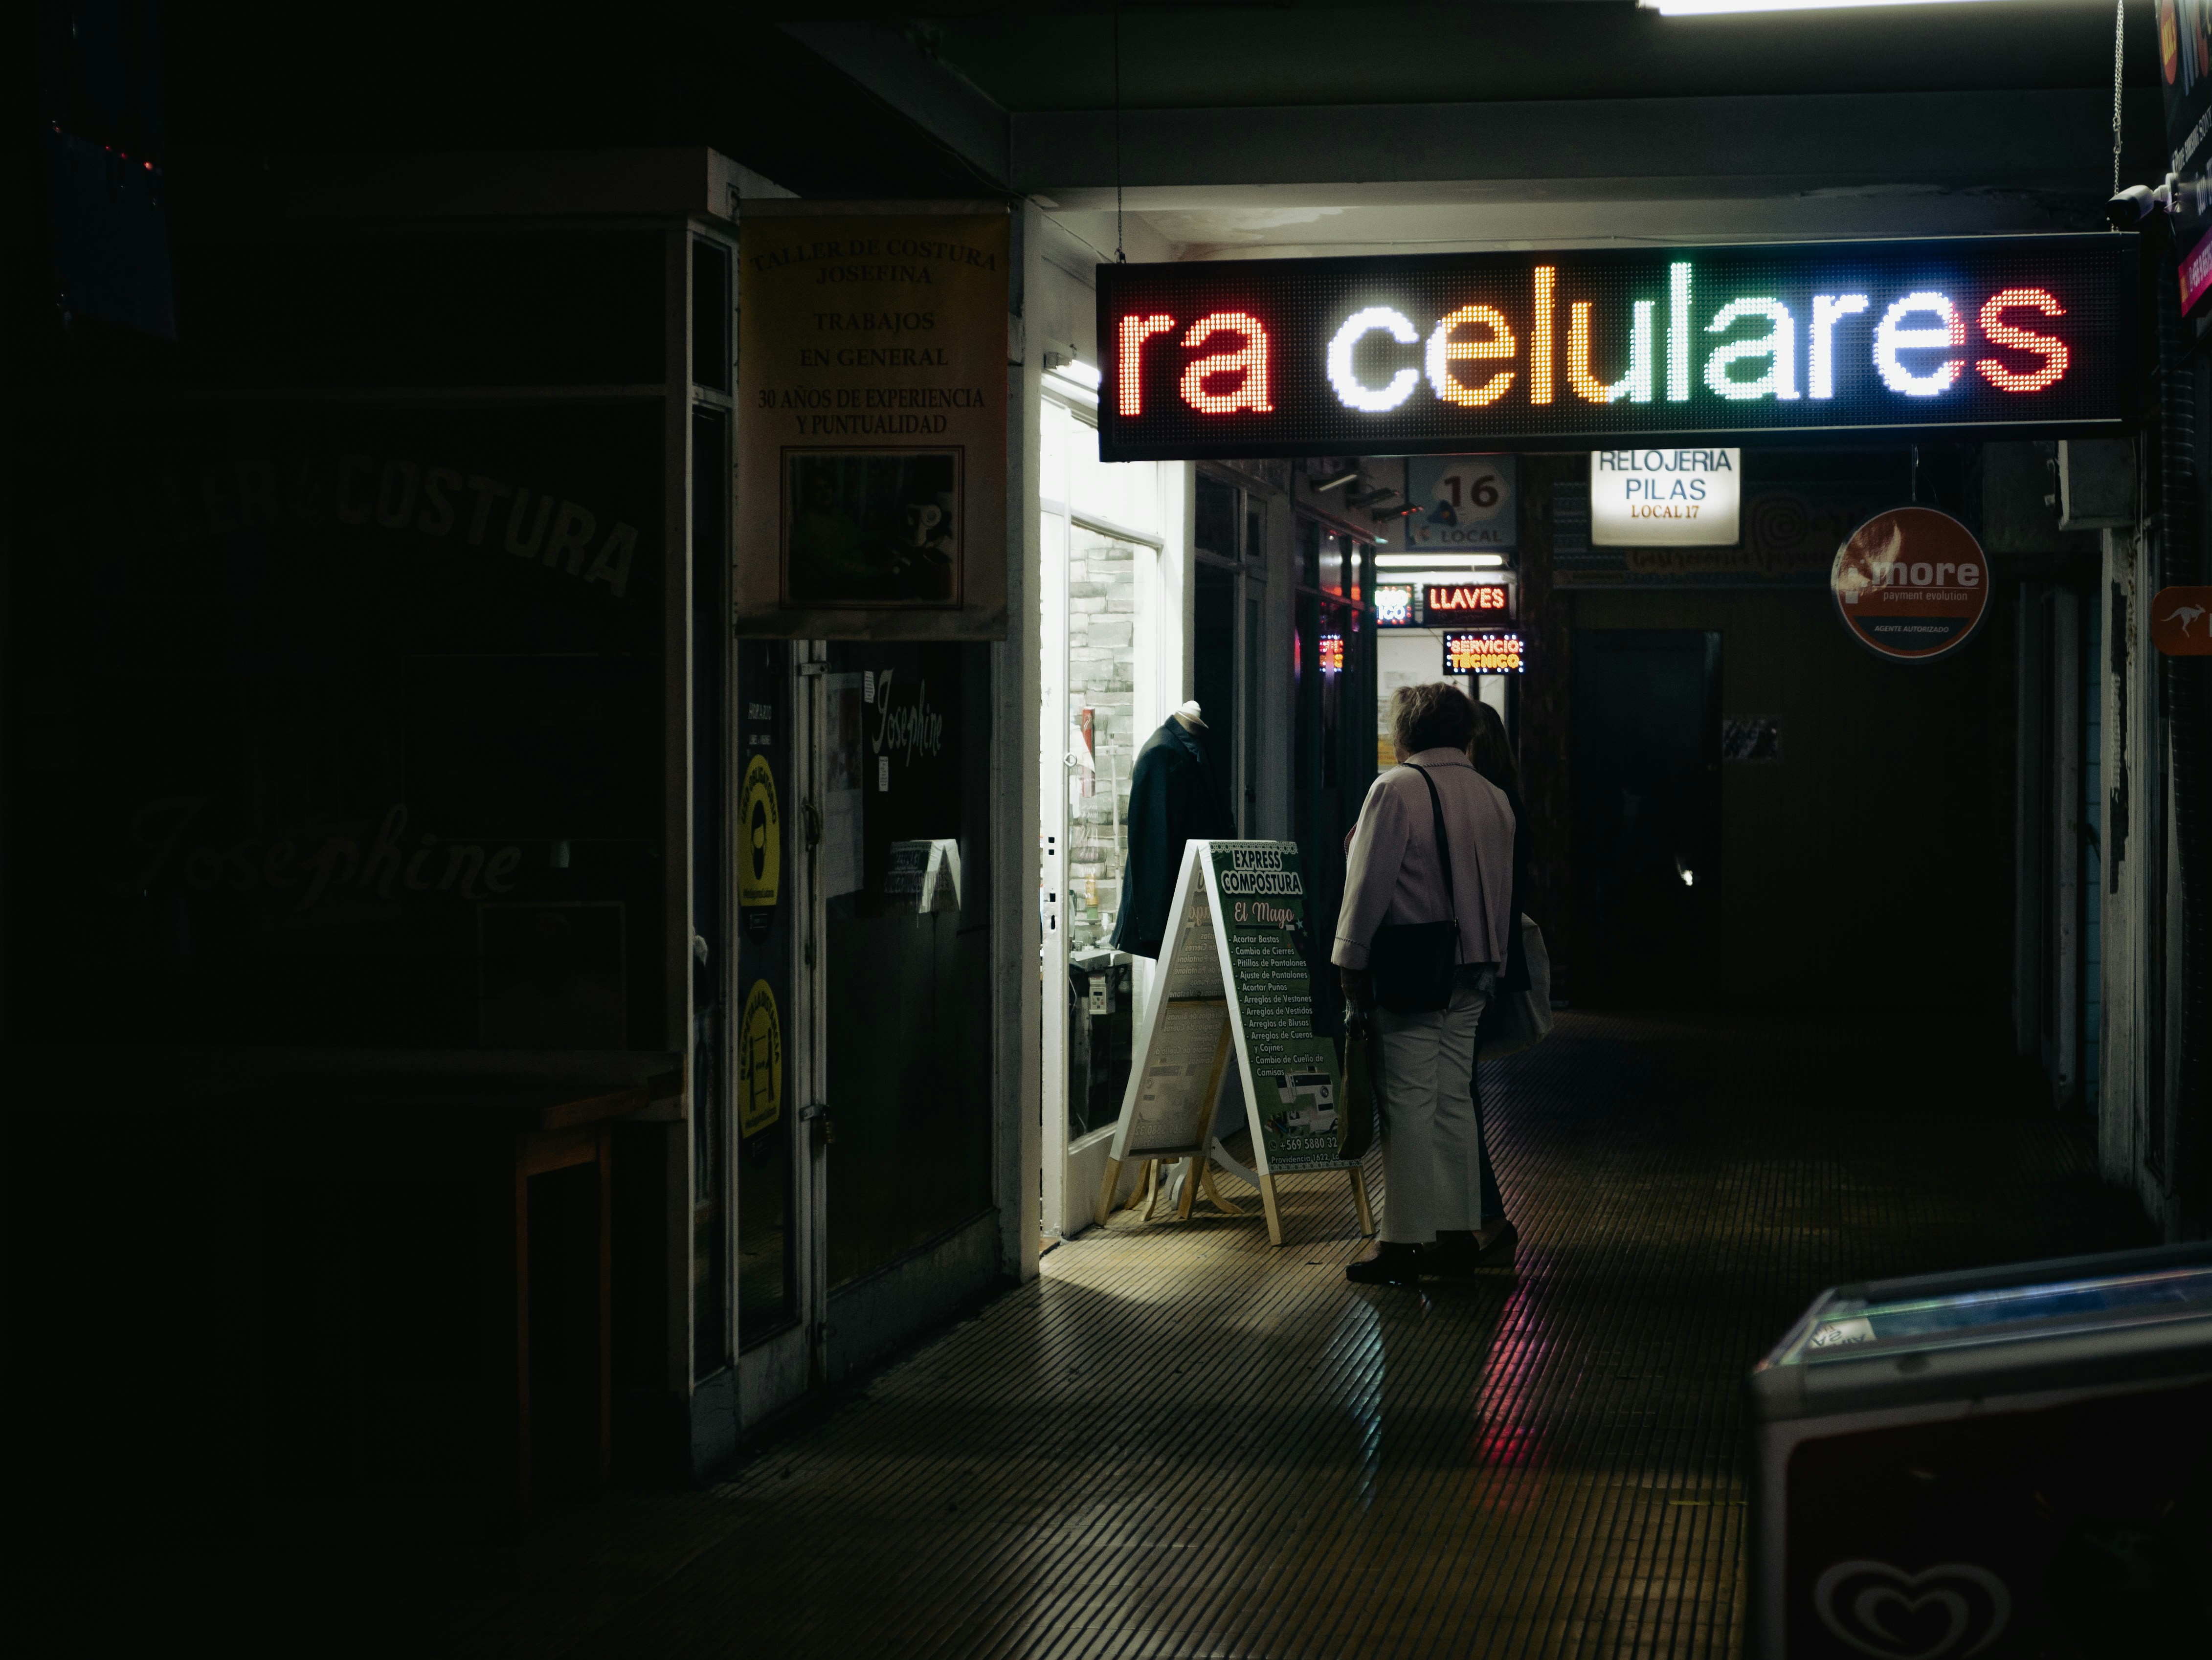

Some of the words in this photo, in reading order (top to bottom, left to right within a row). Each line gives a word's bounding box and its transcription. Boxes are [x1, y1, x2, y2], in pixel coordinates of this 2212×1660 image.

[749, 241, 841, 273] TALLER
[849, 239, 880, 257] DE
[887, 239, 997, 271] COSTURA
[816, 265, 932, 285] JOSEFINA
[813, 312, 935, 334] TRABAJOS
[1117, 310, 1273, 417] ra
[1325, 262, 2070, 412] celulares
[800, 349, 830, 366] EN
[837, 348, 948, 366] GENERAL
[759, 390, 776, 408] 30
[781, 385, 831, 408] AÑOS
[837, 390, 860, 408] DE
[866, 389, 985, 408] EXPERIENCIA
[796, 416, 808, 434] Y
[812, 414, 947, 434] PUNTUALIDAD
[1600, 450, 1732, 471] RELOJERIA
[1445, 475, 1499, 508] 16
[1626, 478, 1706, 500] PILAS
[1631, 504, 1683, 518] LOCAL
[1686, 505, 1700, 518] 17
[335, 453, 640, 598] COSTURA
[1442, 529, 1501, 543] LOCAL
[1430, 588, 1504, 609] LLAVES
[1883, 591, 1922, 601] payment
[1926, 591, 1967, 600] evolution
[1451, 640, 1519, 653] SERVICIO
[871, 668, 942, 767] Josephine
[96, 793, 522, 914] Josephine
[1233, 850, 1282, 870] EXPRESS
[1222, 871, 1302, 893] COMPOSTURA
[1234, 902, 1248, 922] El
[1252, 902, 1295, 929] Mago
[1233, 935, 1256, 944] Acortar
[1258, 935, 1279, 943] Bastas
[1235, 947, 1260, 955] Cambio
[1262, 947, 1271, 955] de
[1272, 946, 1295, 955] Cierres
[1237, 958, 1259, 967] Pitillos
[1260, 958, 1269, 967] de
[1271, 958, 1307, 967] Pantalones
[1240, 971, 1259, 981] Ajuste
[1261, 971, 1270, 979] de
[1272, 970, 1308, 979] Pantalones
[1242, 983, 1266, 992] Acortar
[1268, 982, 1287, 991] Puños
[1244, 995, 1271, 1005] Arreglos
[1283, 995, 1312, 1003] Vestones
[1246, 1007, 1274, 1017] Arreglos
[1249, 1020, 1276, 1029] Arreglos
[1288, 1018, 1309, 1027] Blusas
[1251, 1032, 1278, 1041] Arreglos
[1291, 1031, 1313, 1039] Cueros
[1260, 1044, 1284, 1054] Cojines
[1255, 1056, 1281, 1064] Cambio
[1283, 1055, 1292, 1063] de
[1293, 1055, 1314, 1063] Cuello
[1315, 1054, 1323, 1062] de
[1256, 1068, 1285, 1077] Camisas
[1280, 1139, 1301, 1151] +569
[1304, 1138, 1324, 1150] 5880
[1272, 1155, 1310, 1164] Providencia
[1312, 1153, 1331, 1163] 1622,
